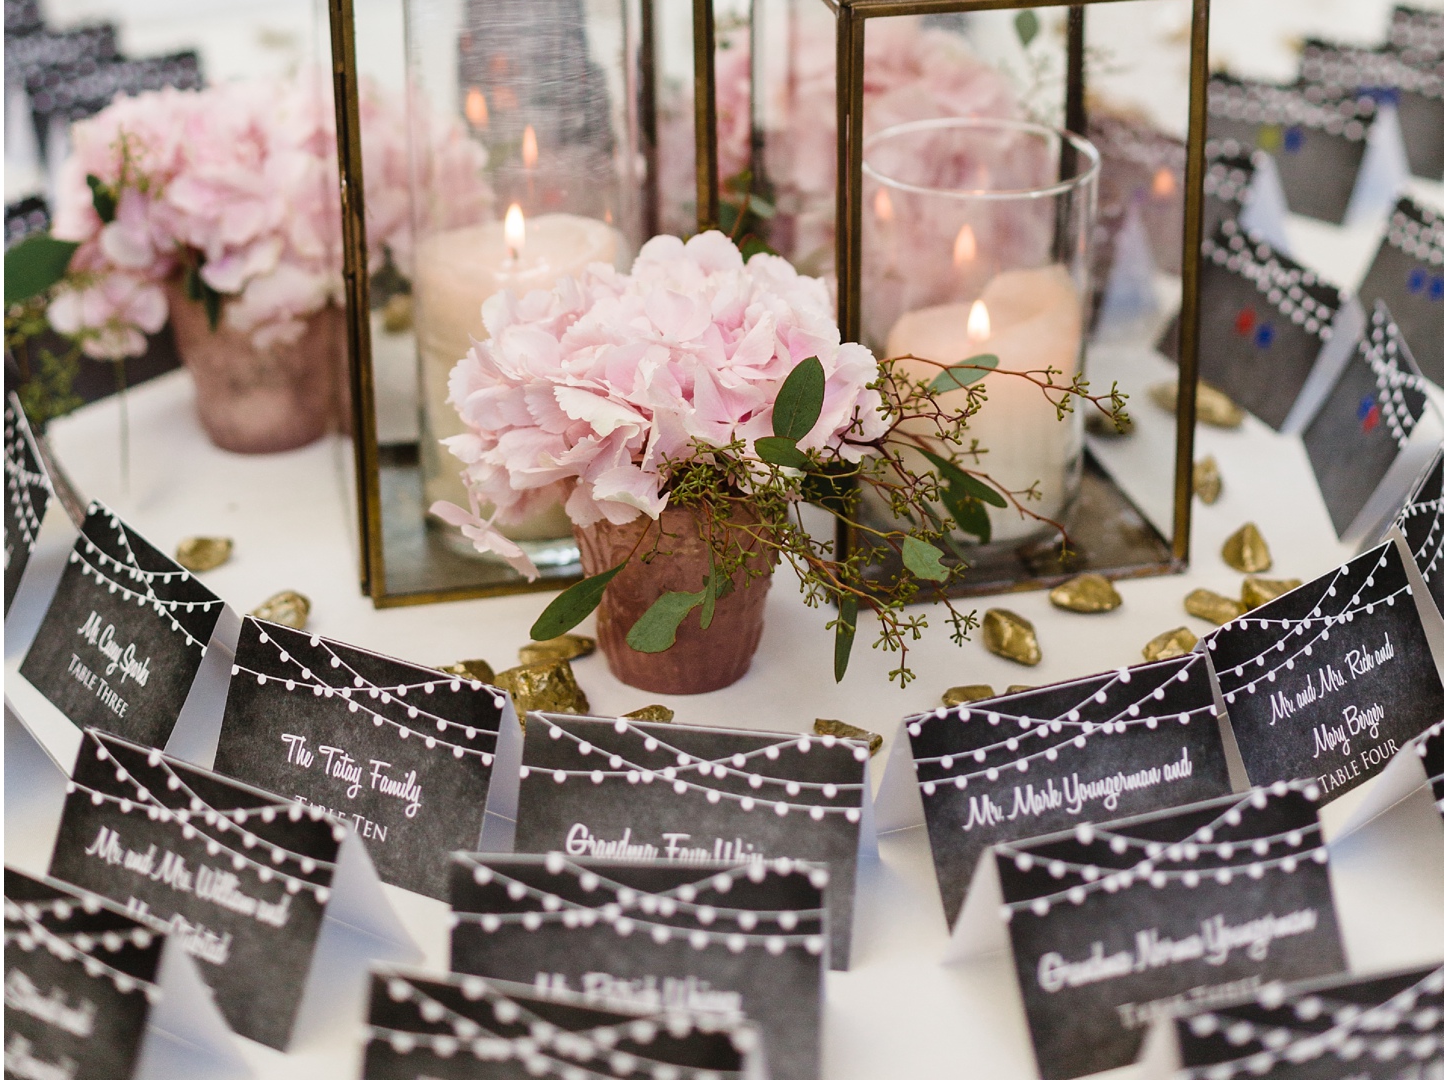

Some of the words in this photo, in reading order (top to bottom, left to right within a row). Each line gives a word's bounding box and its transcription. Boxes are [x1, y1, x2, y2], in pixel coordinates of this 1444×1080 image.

[68, 653, 98, 691] TABLE
[96, 678, 129, 718] THREE
[1269, 691, 1296, 726] Mr.
[1296, 674, 1317, 709] and
[1318, 664, 1348, 698] Mrs.
[1344, 644, 1375, 679] Rick
[1375, 632, 1395, 665] and
[1312, 723, 1350, 758] Mary
[1342, 703, 1384, 739] Berger
[281, 733, 314, 768] The
[319, 745, 362, 799] Tatay
[369, 759, 422, 818] Family
[962, 794, 1004, 831] Mr.
[1008, 778, 1062, 820] Mark
[1063, 767, 1161, 814] Youngerman
[1164, 746, 1193, 782] and
[1317, 759, 1360, 794] TABLE
[1360, 738, 1400, 770] FOUR
[352, 813, 388, 842] TEN
